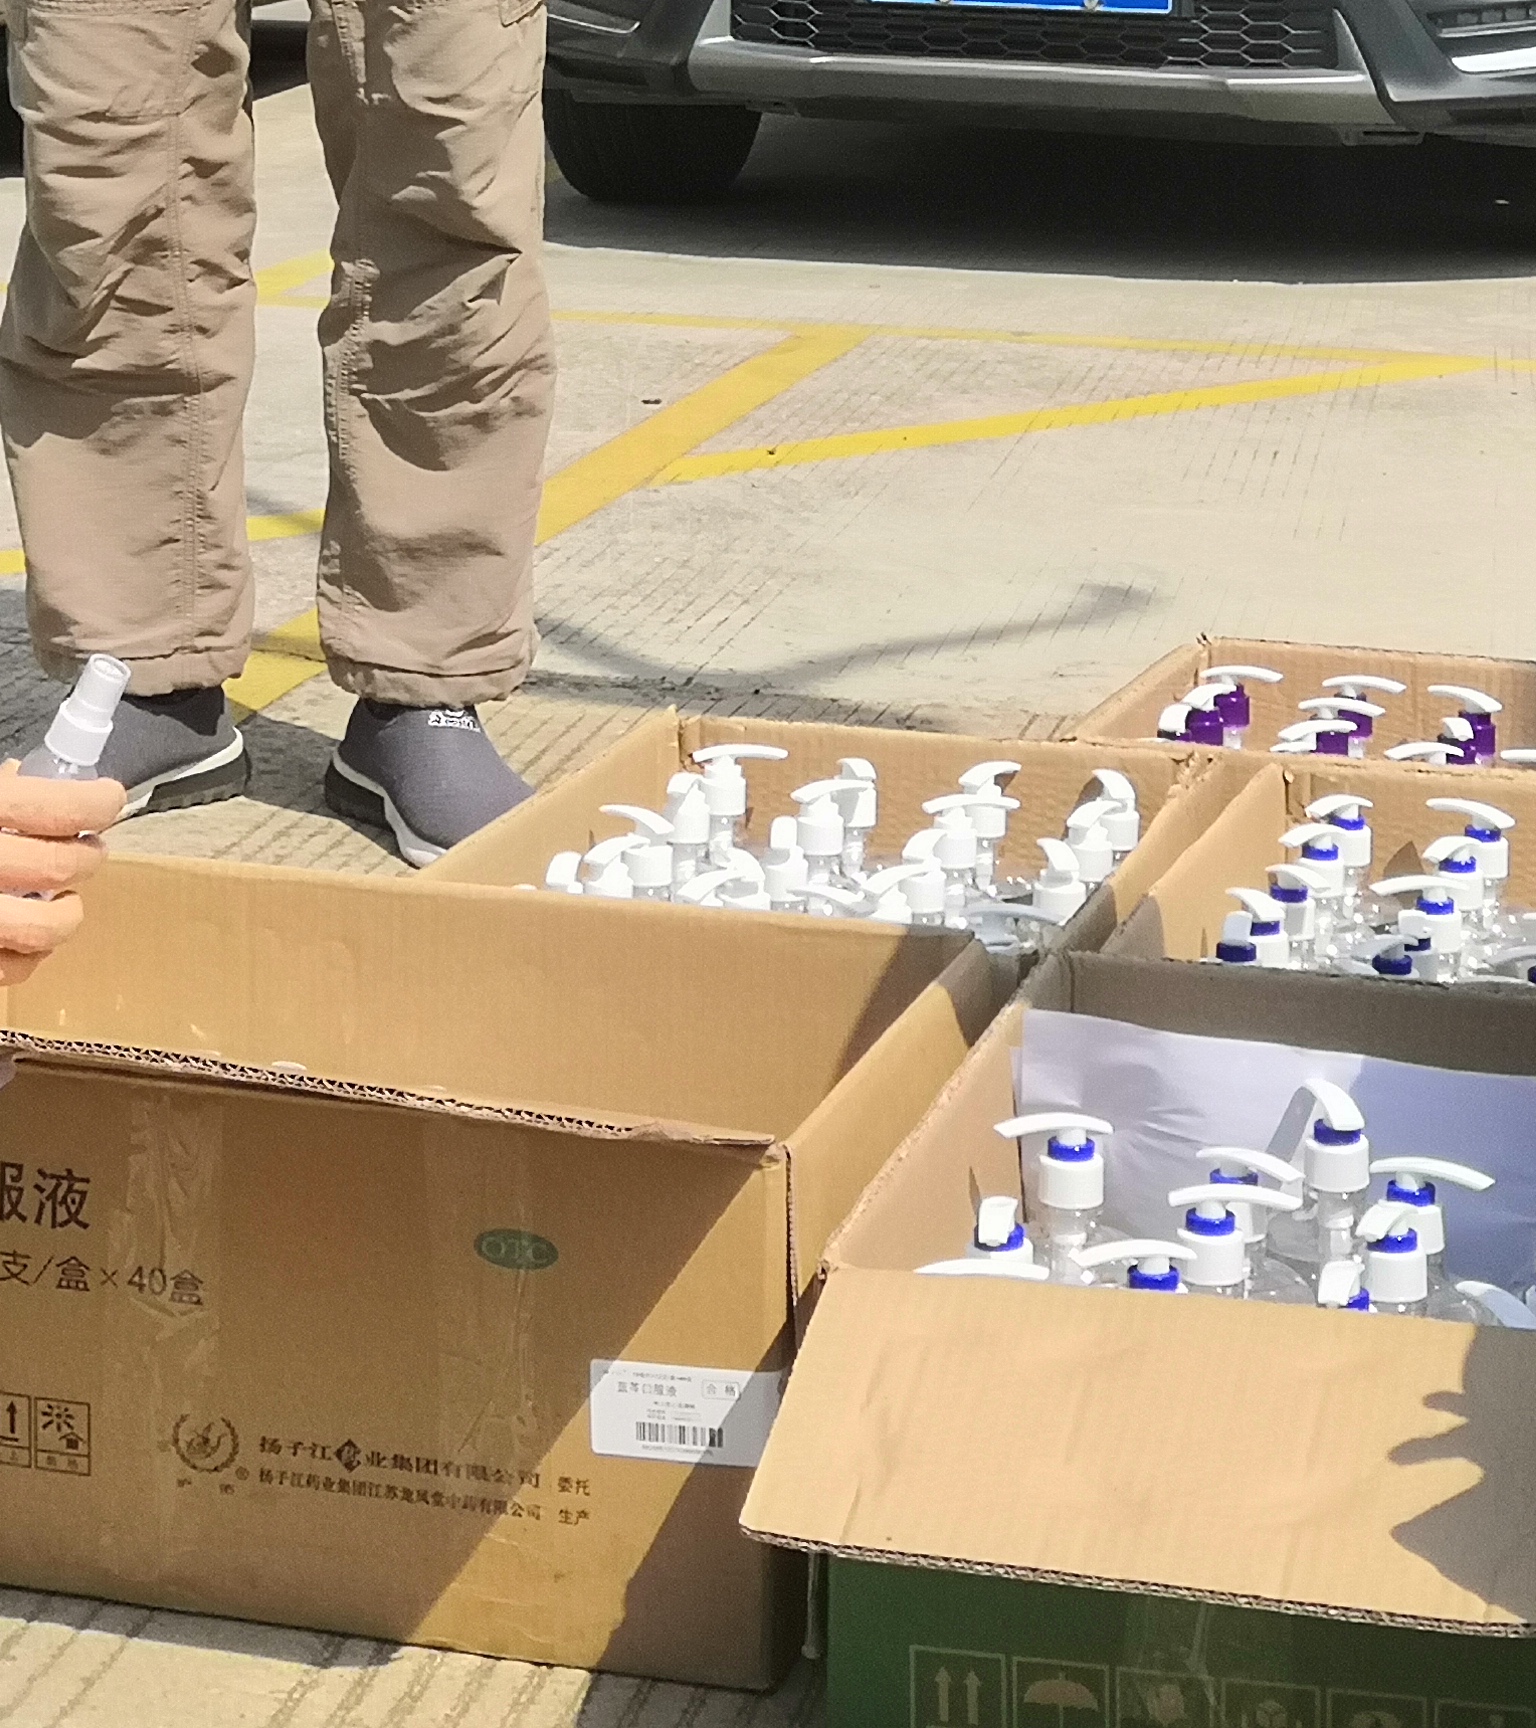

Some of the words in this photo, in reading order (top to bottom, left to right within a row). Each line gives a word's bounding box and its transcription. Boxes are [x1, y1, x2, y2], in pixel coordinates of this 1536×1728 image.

[481, 1235, 549, 1265] OTC
[557, 1475, 591, 1497] 委托
[557, 1508, 591, 1526] 生产
